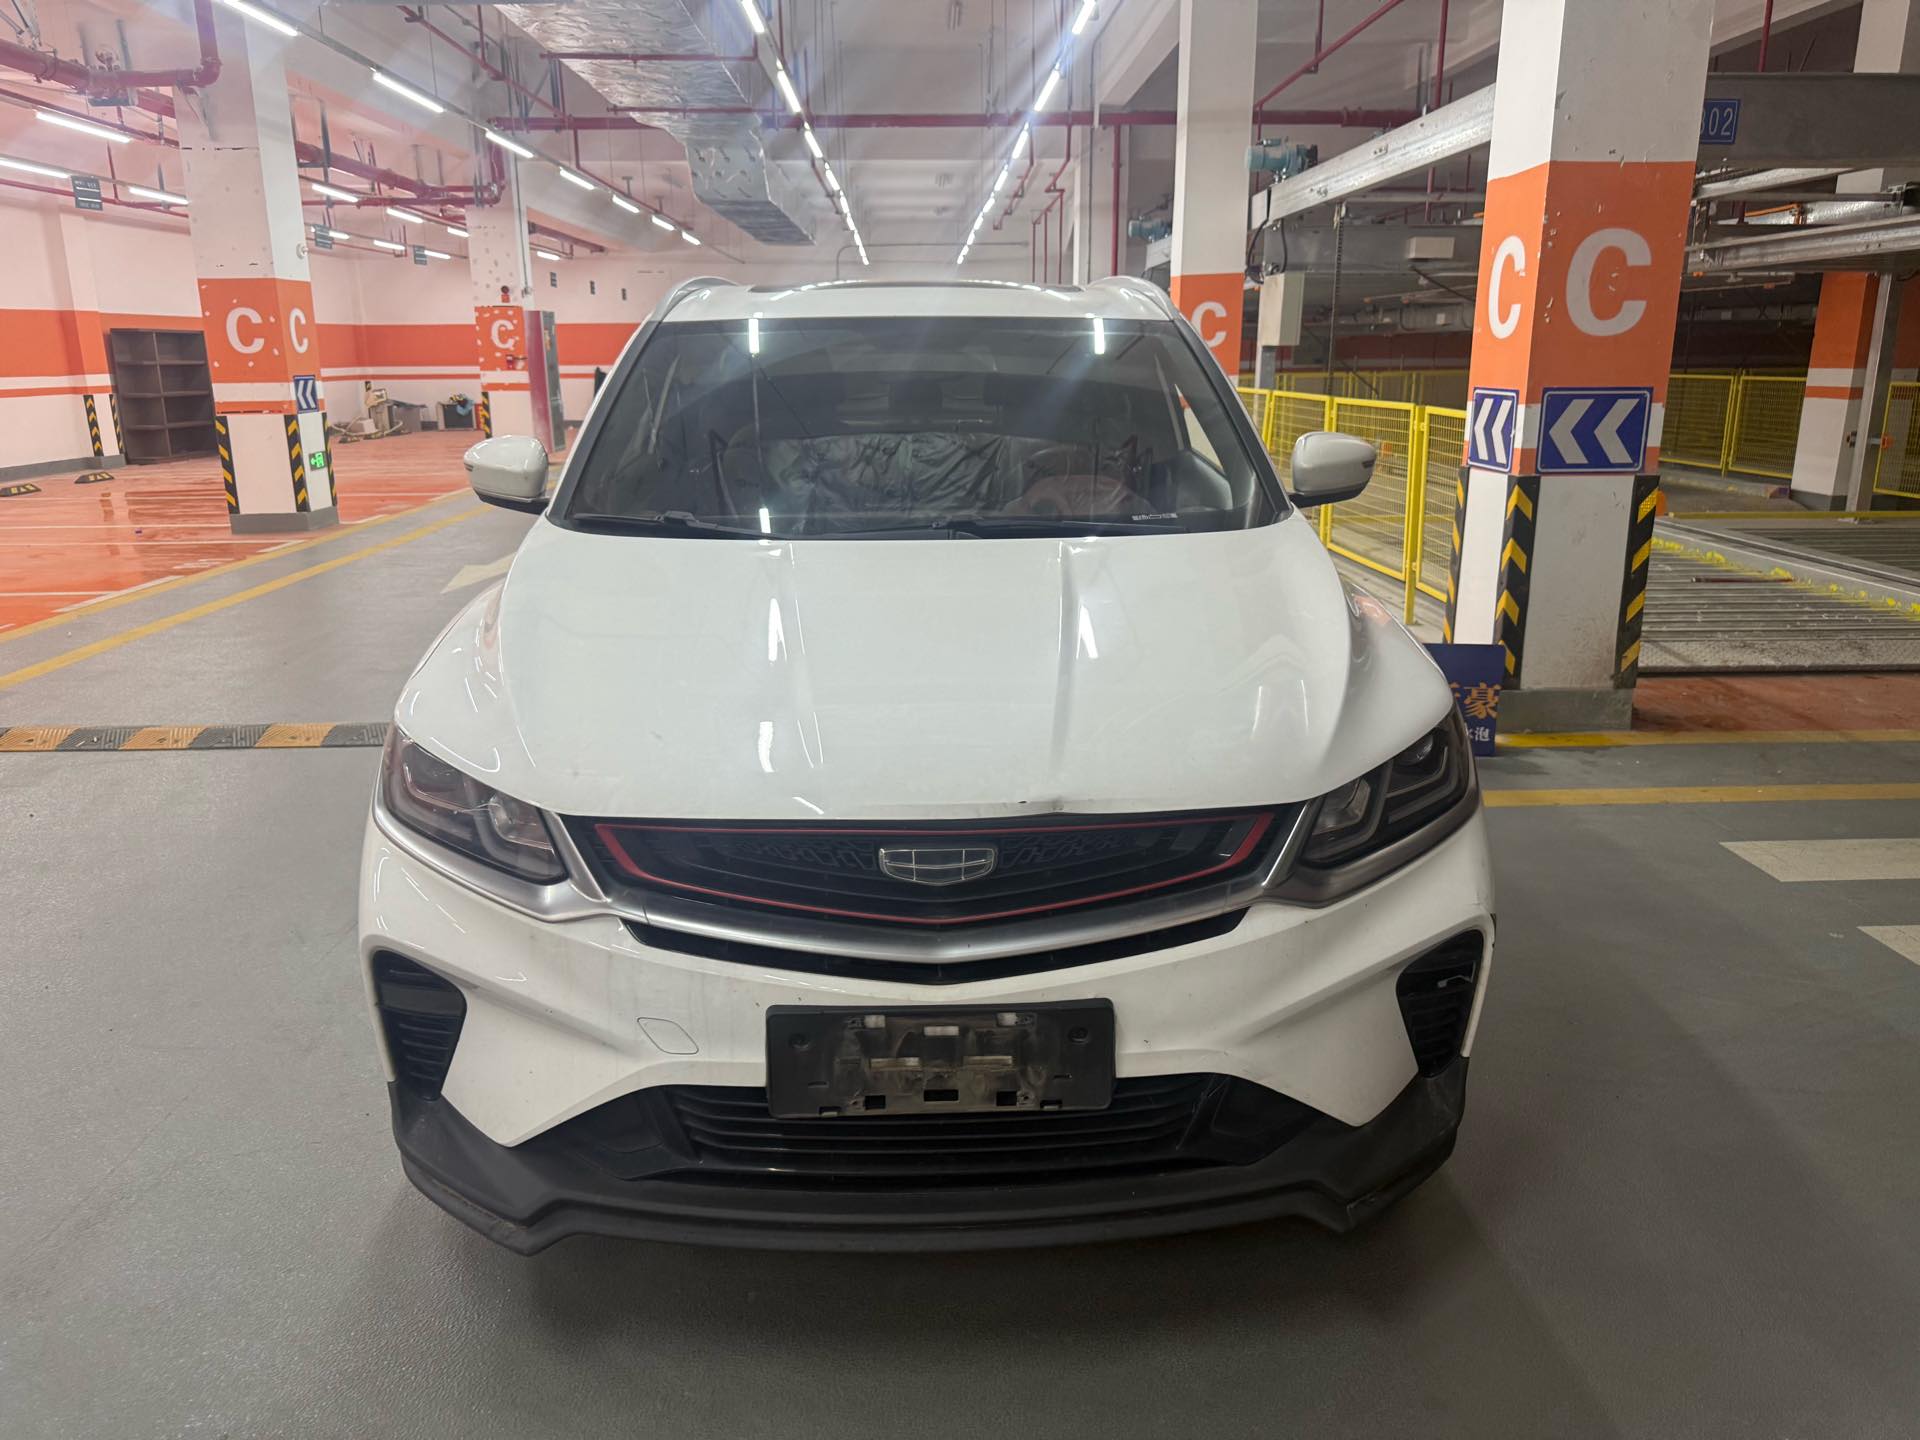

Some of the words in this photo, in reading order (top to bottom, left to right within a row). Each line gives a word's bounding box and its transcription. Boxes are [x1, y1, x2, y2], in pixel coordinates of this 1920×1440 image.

[1488, 235, 1525, 339] C
[1565, 227, 1652, 337] C
[226, 307, 264, 354] C
[289, 307, 309, 354] C
[491, 319, 515, 349] C
[1191, 301, 1227, 349] C
[1450, 682, 1501, 719] 豪
